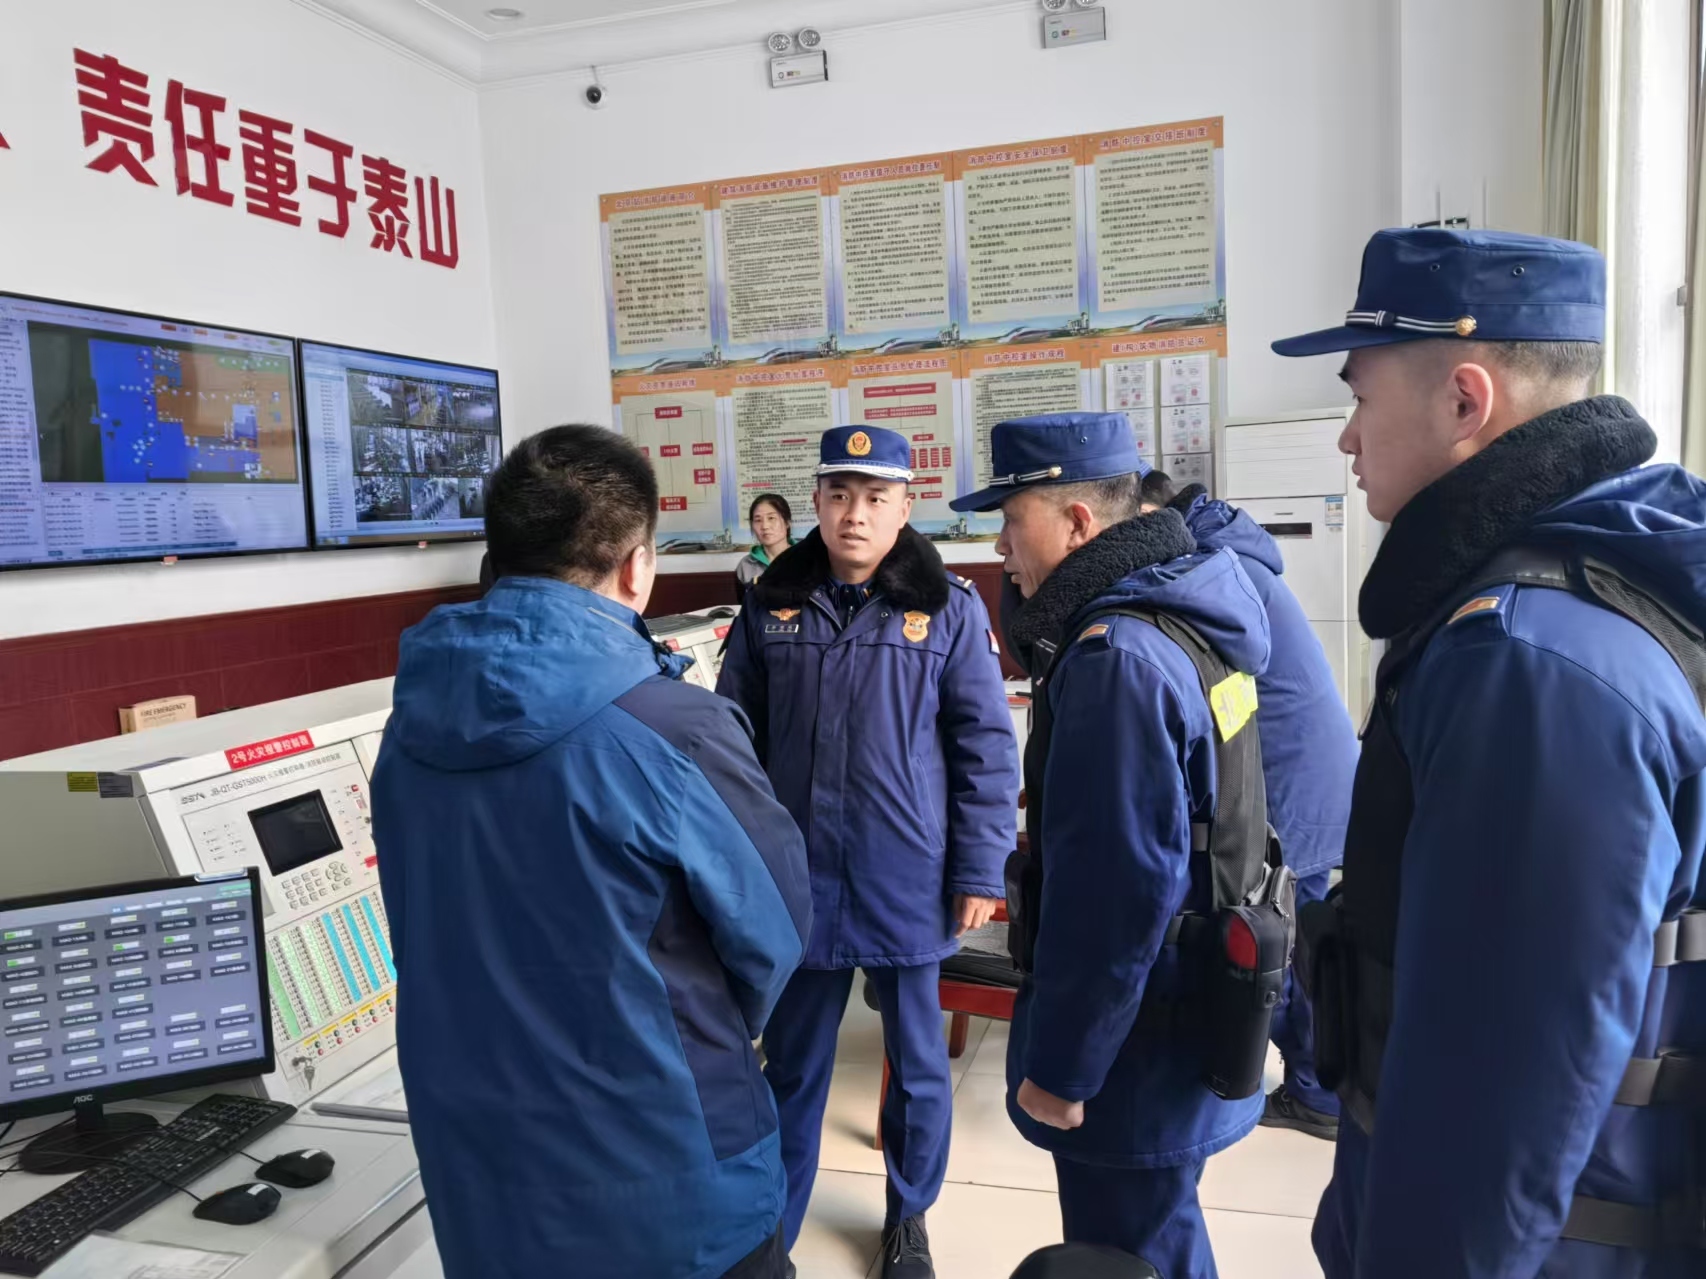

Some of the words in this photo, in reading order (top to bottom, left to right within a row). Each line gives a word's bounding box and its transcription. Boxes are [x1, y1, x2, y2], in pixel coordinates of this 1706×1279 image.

[73, 47, 459, 270] 责任重于泰山
[153, 703, 187, 715] EMERGENCY
[231, 734, 310, 764] 2号火灾报警控制器
[73, 1094, 94, 1104] AOC
